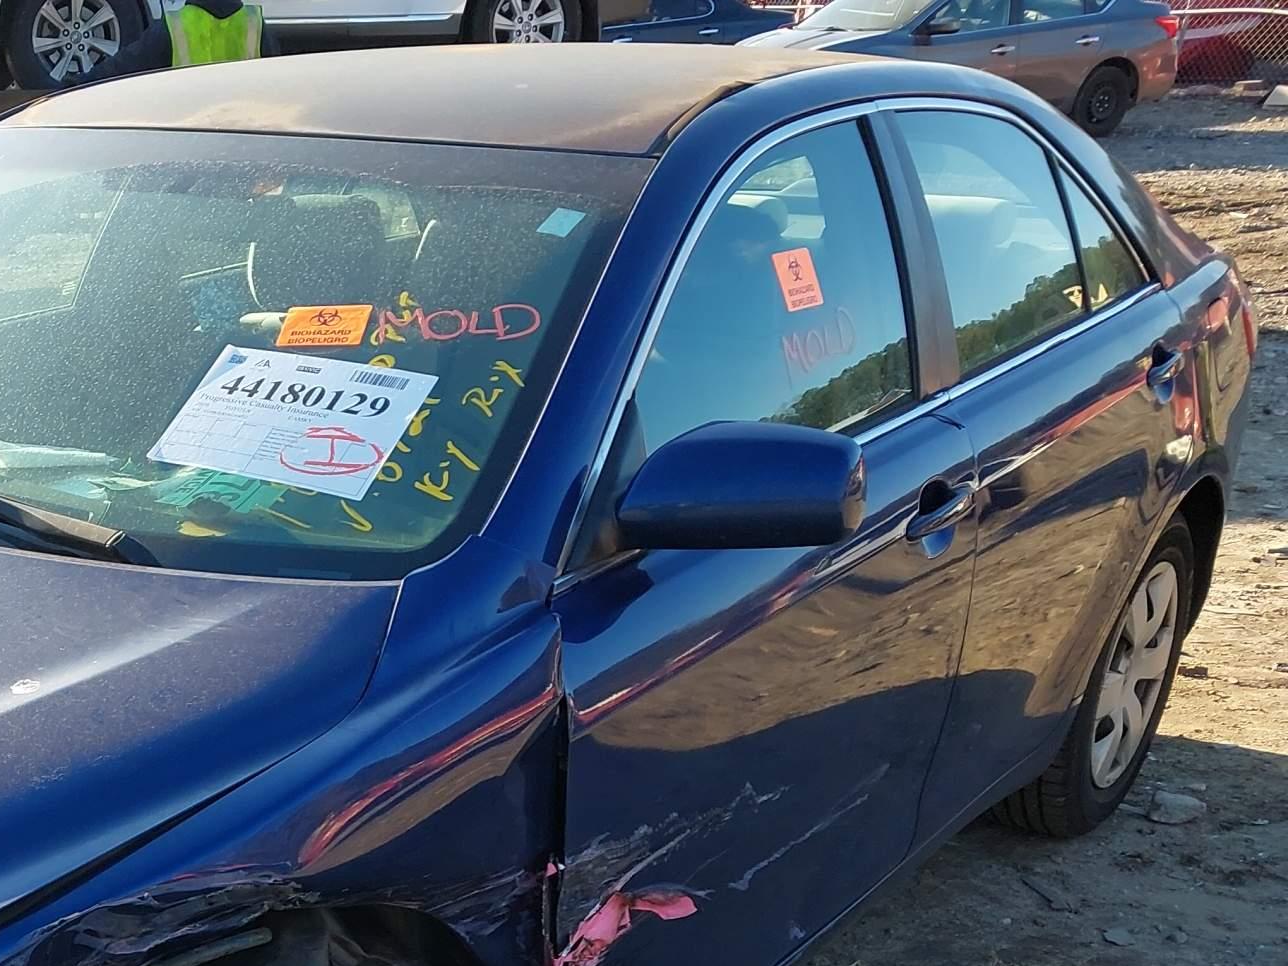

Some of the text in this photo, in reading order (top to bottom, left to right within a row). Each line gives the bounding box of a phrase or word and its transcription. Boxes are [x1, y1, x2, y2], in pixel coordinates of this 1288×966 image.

[286, 336, 349, 344] BIOPELIGRO
[289, 328, 352, 337] BIOHAZARD
[378, 303, 541, 345] MOLD
[781, 306, 856, 390] MOLD
[199, 392, 247, 406] Progressive
[249, 398, 286, 412] Casualty
[287, 405, 330, 419] Insurance
[220, 375, 391, 418] 44180129
